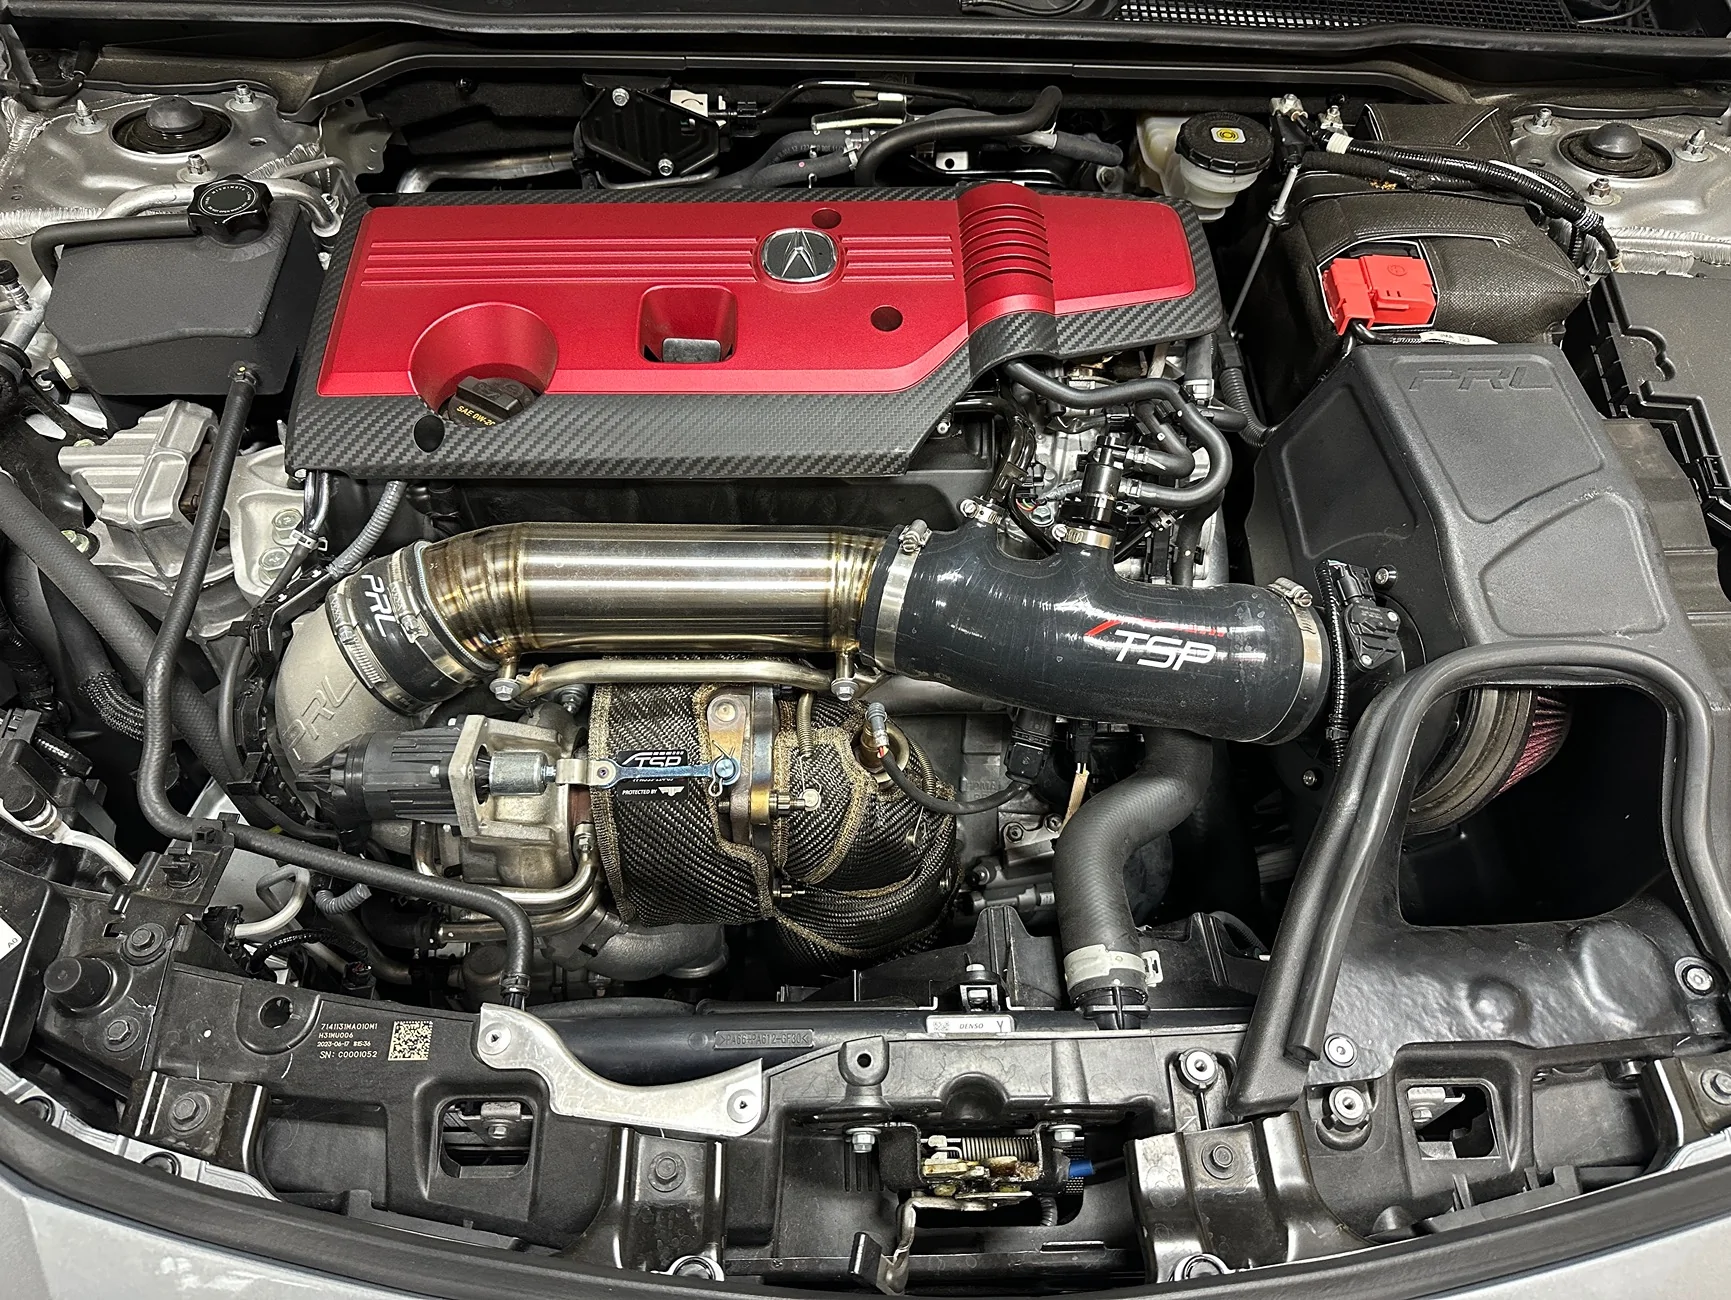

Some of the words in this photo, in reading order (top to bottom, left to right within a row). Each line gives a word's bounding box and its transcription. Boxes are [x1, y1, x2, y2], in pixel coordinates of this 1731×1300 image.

[1408, 366, 1553, 391] PRL
[456, 405, 475, 417] SAE
[361, 574, 397, 637] PRL
[1115, 629, 1217, 671] TSP
[282, 675, 358, 761] PRL
[634, 756, 682, 768] TSP
[319, 1051, 336, 1059] SN:
